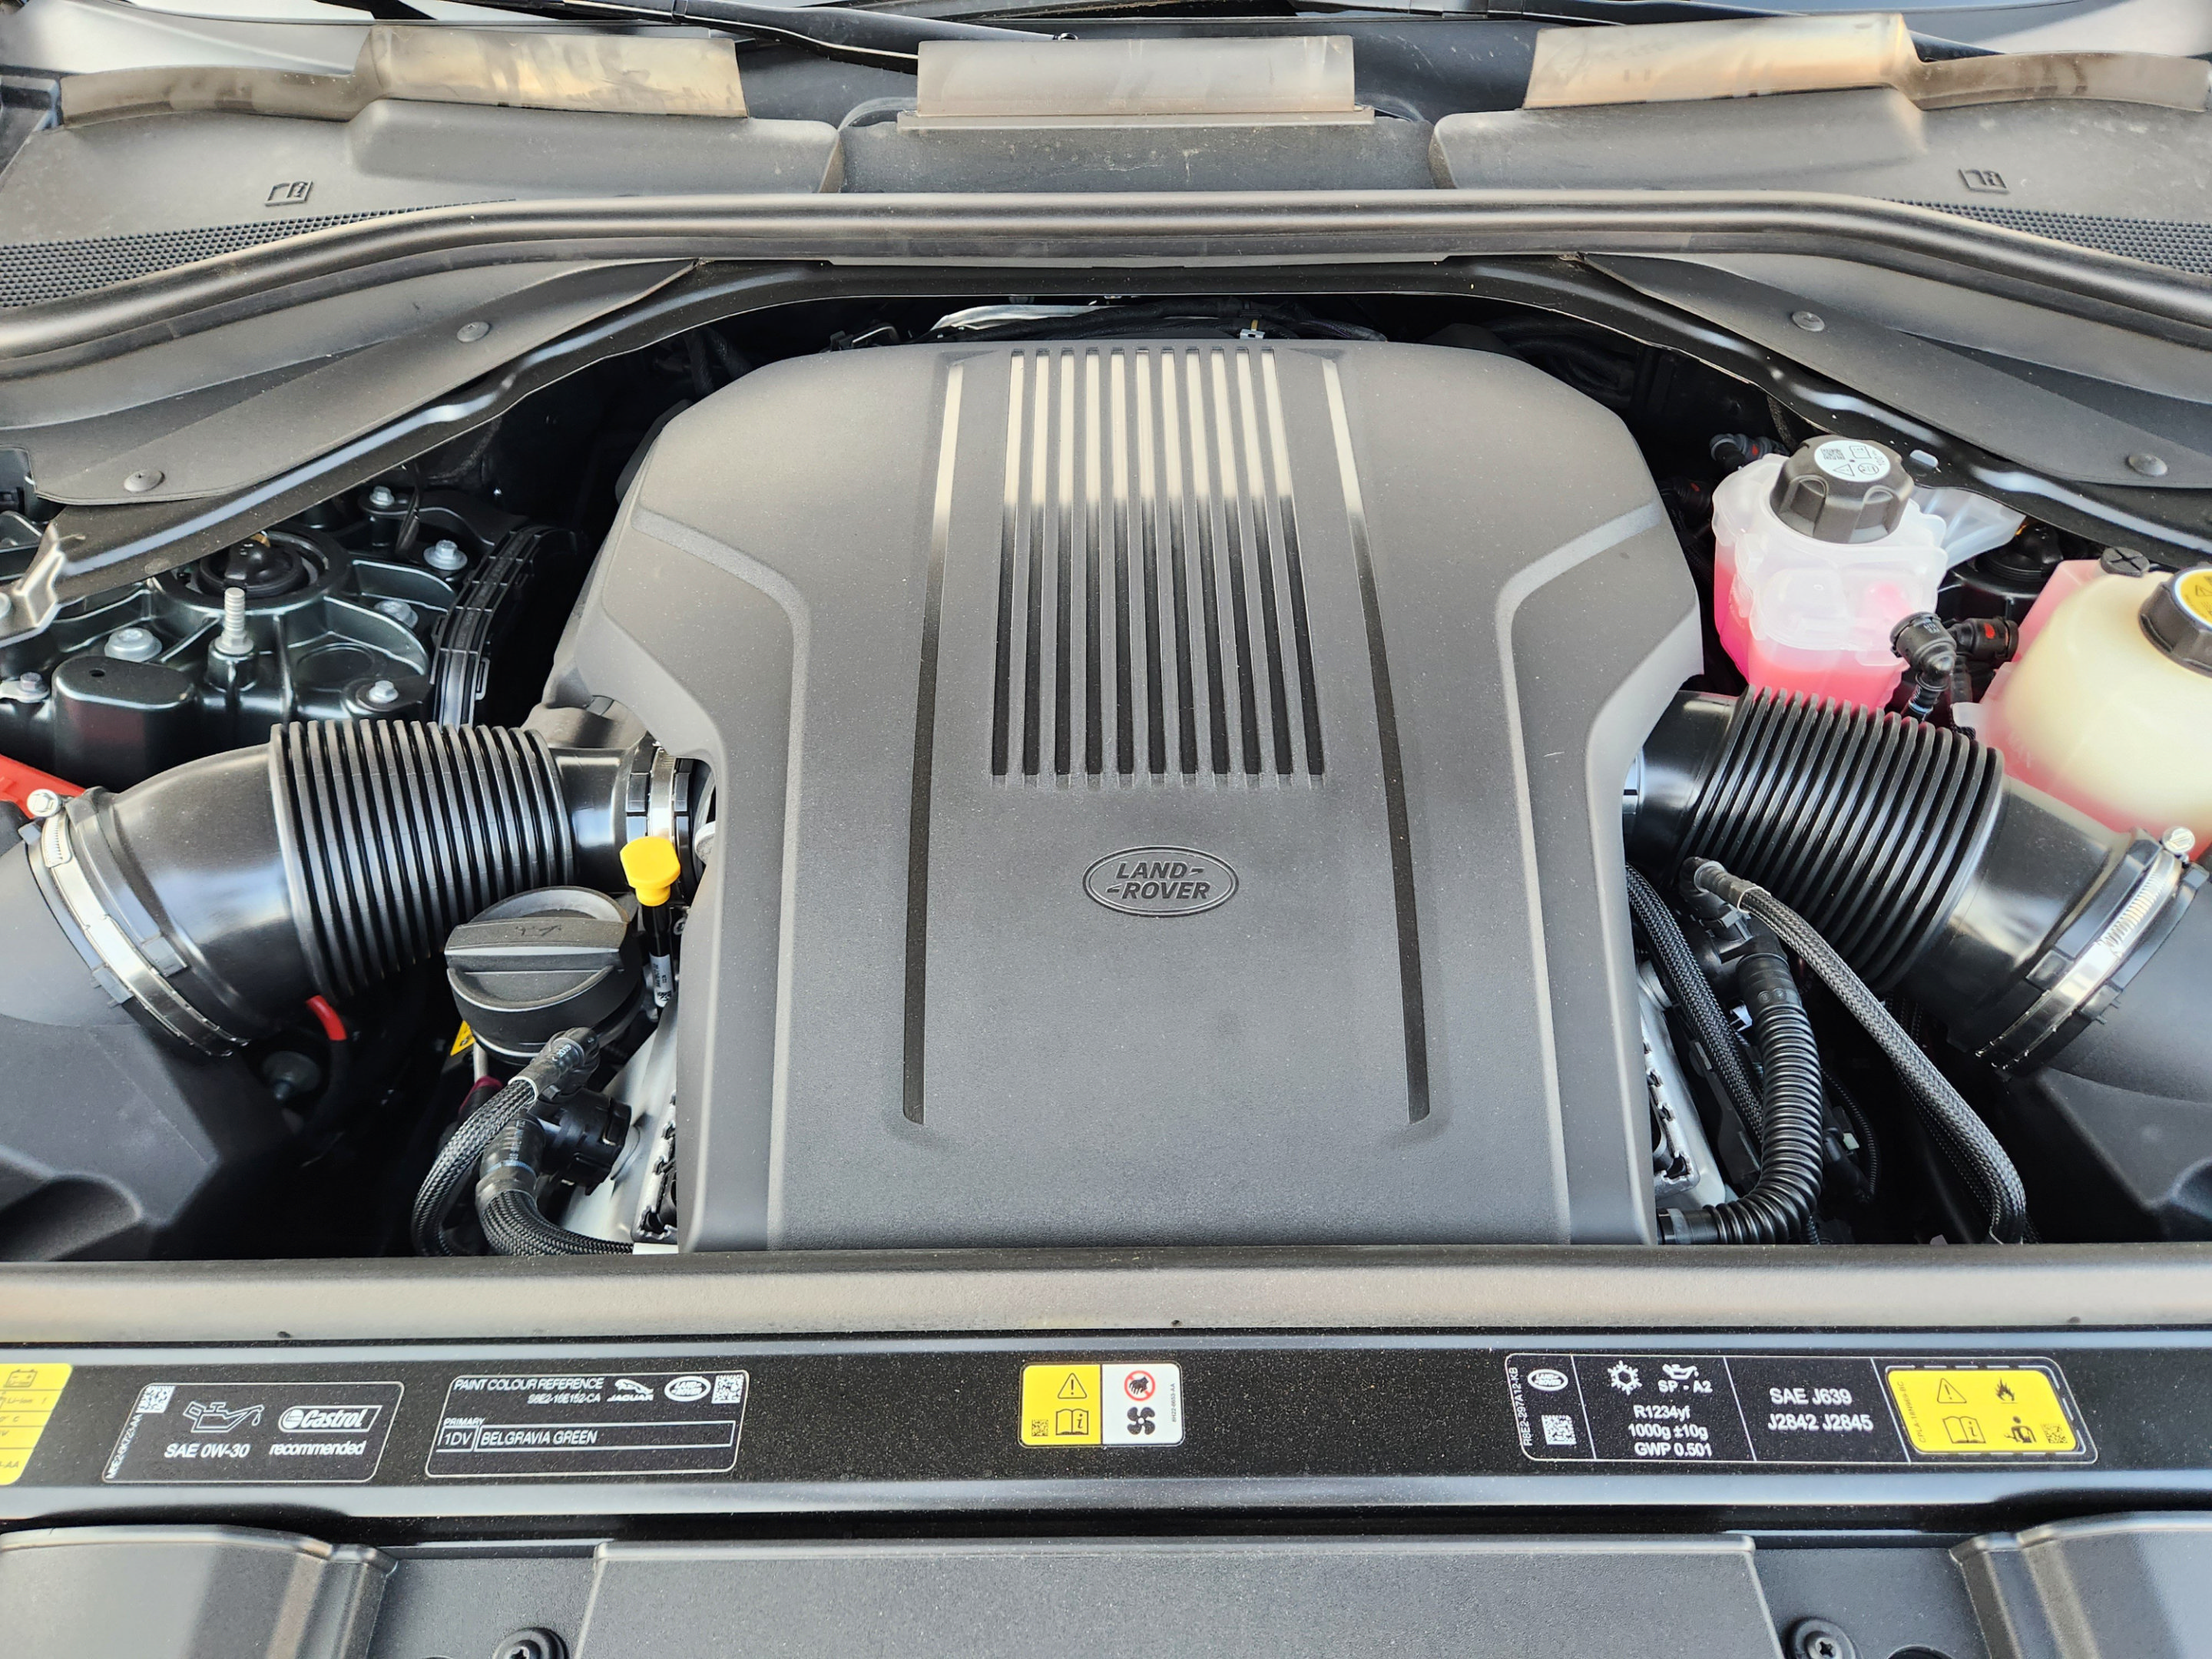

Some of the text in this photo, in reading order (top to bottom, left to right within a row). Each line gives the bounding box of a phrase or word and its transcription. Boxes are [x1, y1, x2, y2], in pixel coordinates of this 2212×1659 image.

[453, 1377, 605, 1391] PAINT COLOUR REFERENCE
[1657, 1379, 1679, 1392] SP
[1693, 1379, 1714, 1394] A2
[1769, 1387, 1853, 1406] SAE J639
[300, 1408, 369, 1429] Castrol
[1633, 1404, 1690, 1422] R1234yf
[443, 1417, 486, 1426] PRIMARY
[1767, 1412, 1874, 1432] J2842 J2845
[444, 1429, 599, 1446] 1DV BELGRAVIA GREEN
[1628, 1423, 1709, 1441] 1000g ±10g
[164, 1442, 251, 1458] SAE 0W-30
[269, 1440, 367, 1456] recommended
[1634, 1442, 1713, 1458] GWP 0.501
